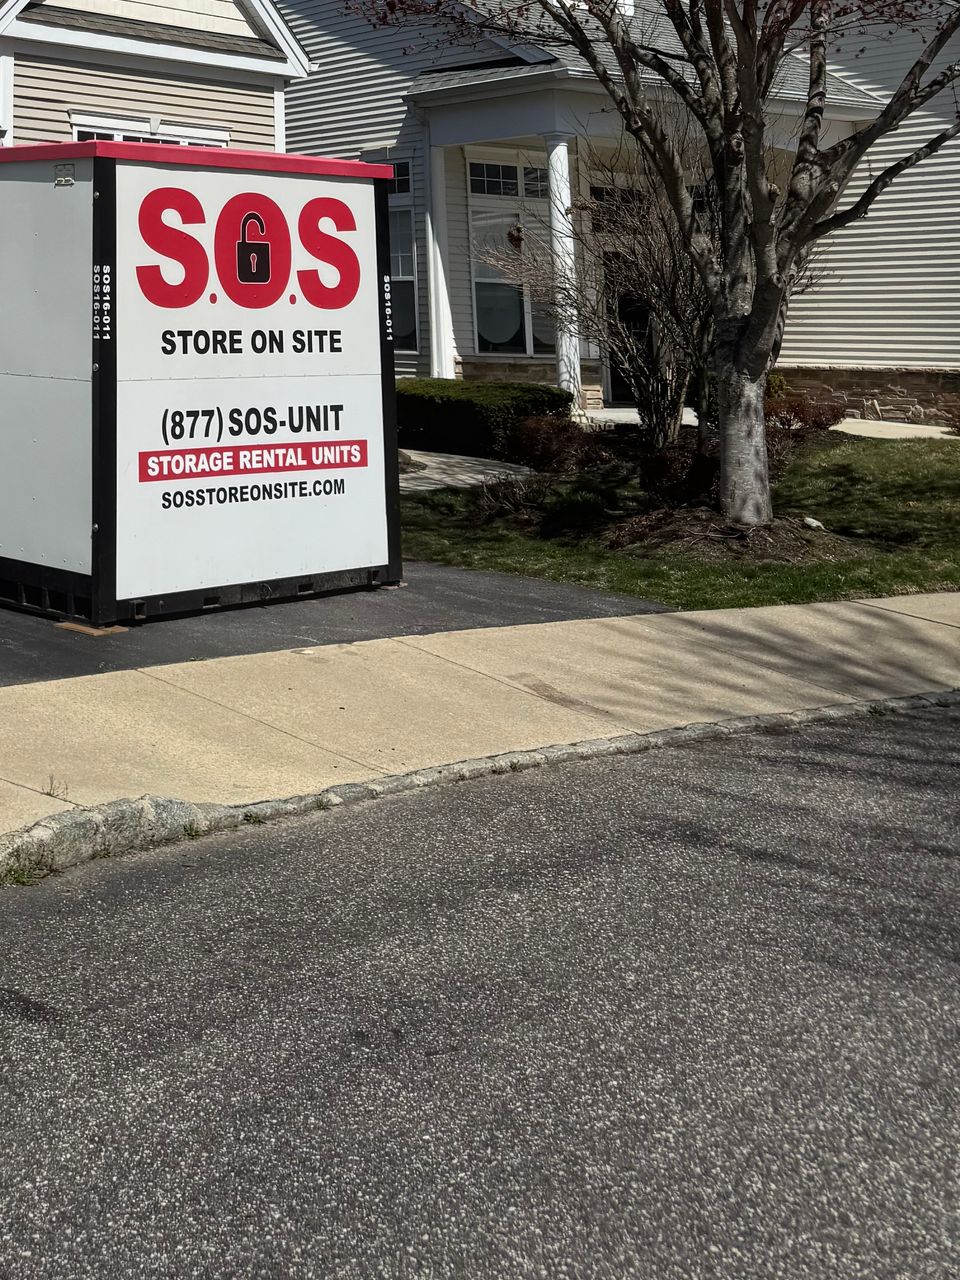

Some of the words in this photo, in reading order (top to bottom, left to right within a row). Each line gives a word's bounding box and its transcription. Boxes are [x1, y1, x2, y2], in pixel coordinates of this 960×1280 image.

[135, 187, 361, 310] S.O.S
[93, 265, 101, 340] SOS16-011
[102, 265, 111, 340] SOS16-011
[383, 275, 393, 341] SOS16-011
[161, 329, 243, 356] STORE
[250, 329, 284, 354] ON
[292, 329, 343, 354] SITE
[161, 406, 224, 446] (877)
[228, 404, 344, 437] SOS-UNIT
[147, 451, 234, 477] STORAGE
[239, 447, 307, 471] RENTAL
[311, 444, 361, 465] UNITS
[161, 478, 345, 510] SOSSTOREONSITE.COM
